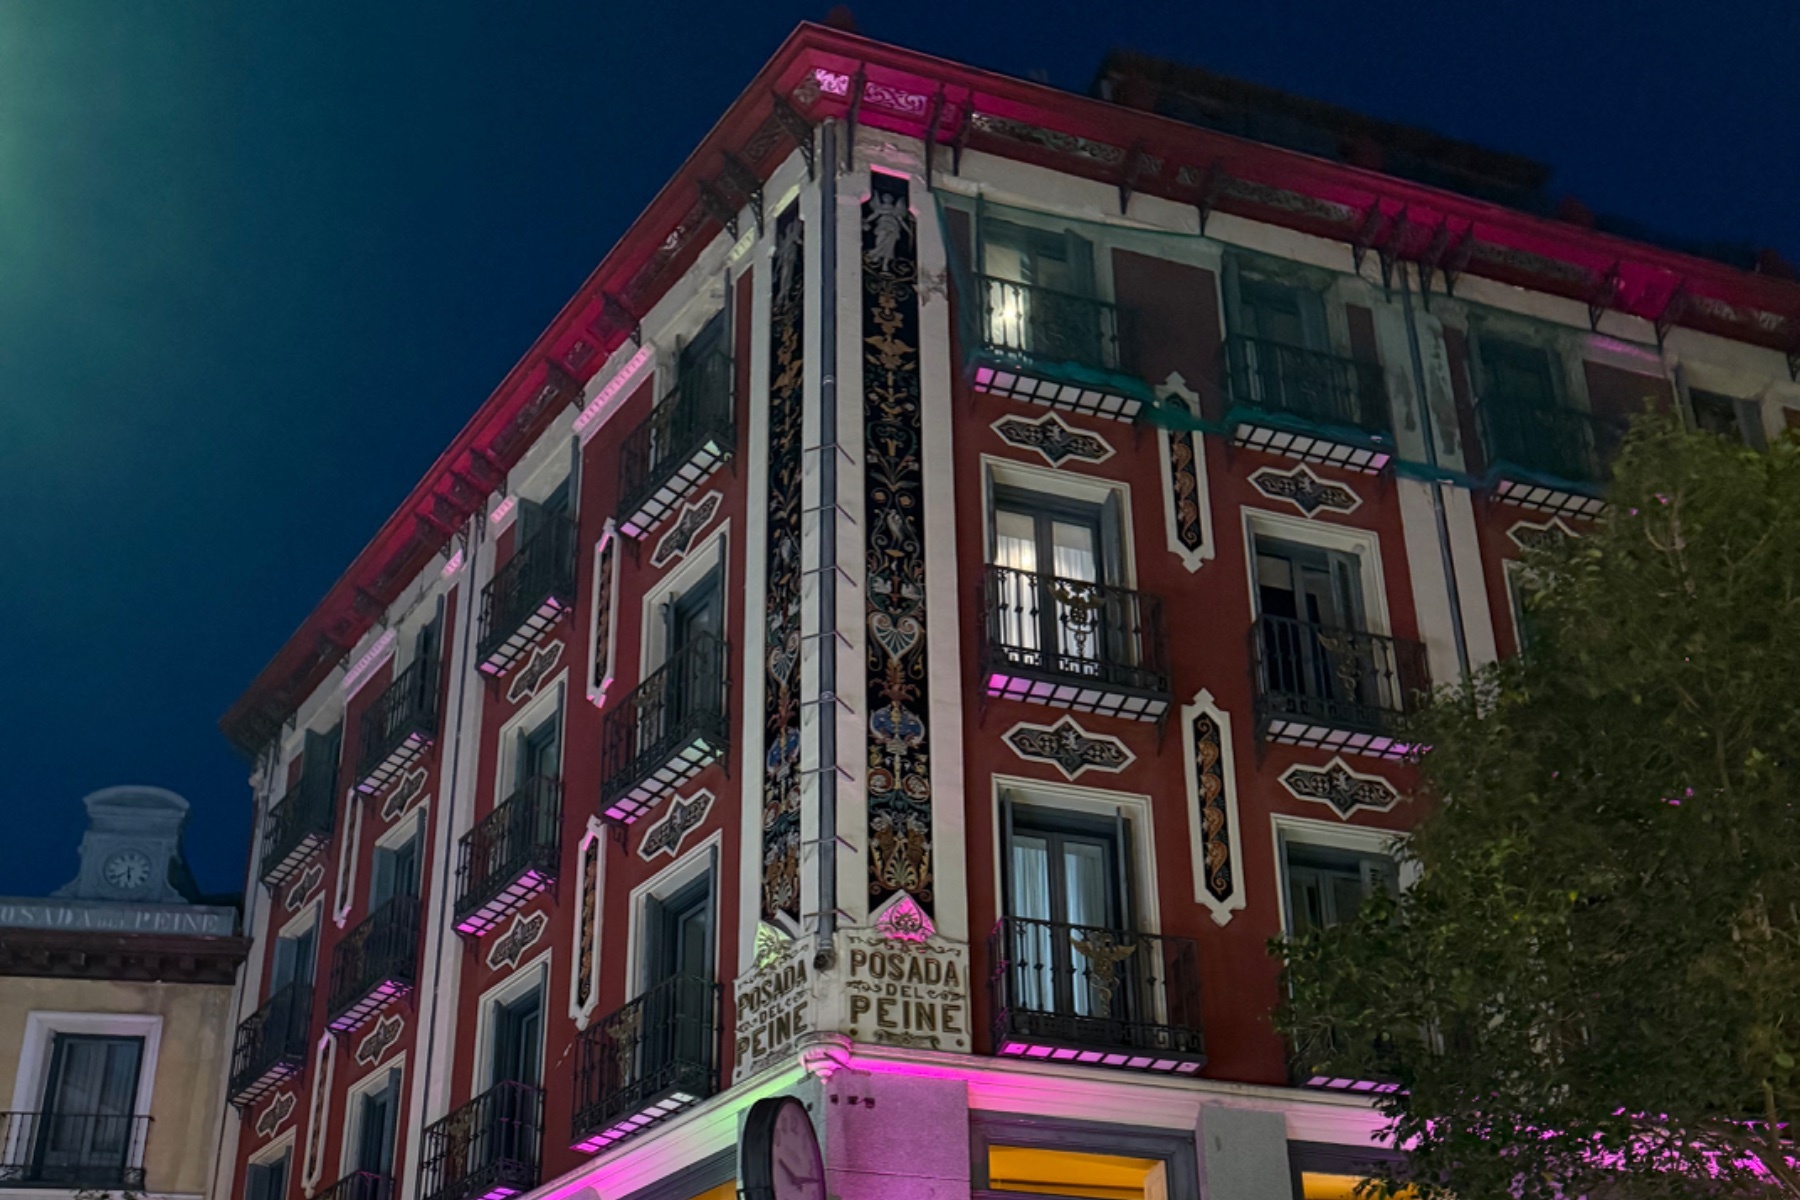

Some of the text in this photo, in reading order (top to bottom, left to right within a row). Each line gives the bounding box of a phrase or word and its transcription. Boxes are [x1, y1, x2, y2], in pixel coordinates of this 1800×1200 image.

[135, 911, 219, 933] PEINE
[851, 949, 960, 988] POSADA
[738, 959, 807, 1021] POSADA
[885, 984, 925, 1000] DEL
[760, 1003, 784, 1024] DEL
[850, 995, 962, 1035] PEINE
[736, 1001, 808, 1067] PEINE
